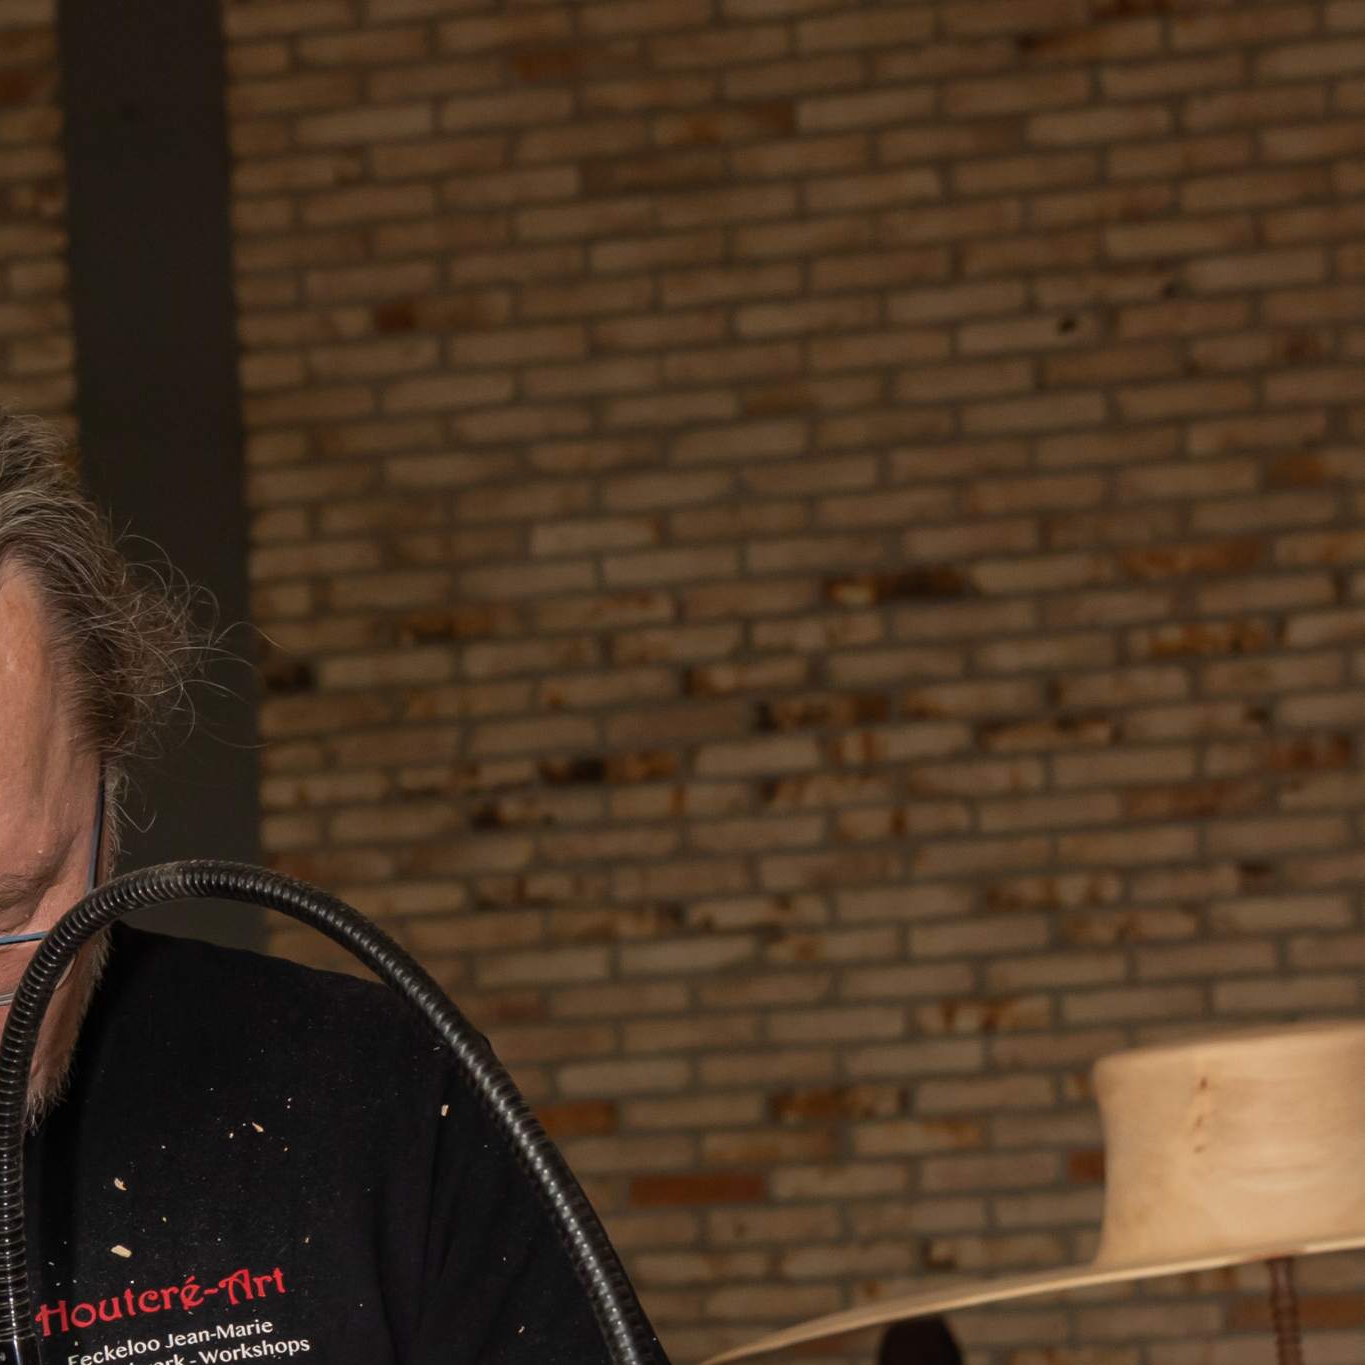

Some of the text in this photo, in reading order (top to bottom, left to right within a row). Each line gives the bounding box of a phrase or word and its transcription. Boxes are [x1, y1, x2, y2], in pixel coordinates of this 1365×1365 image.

[35, 1267, 286, 1337] Houtcré-Art
[165, 1319, 274, 1349] Jean-Marie
[198, 1338, 311, 1365] Workshops
